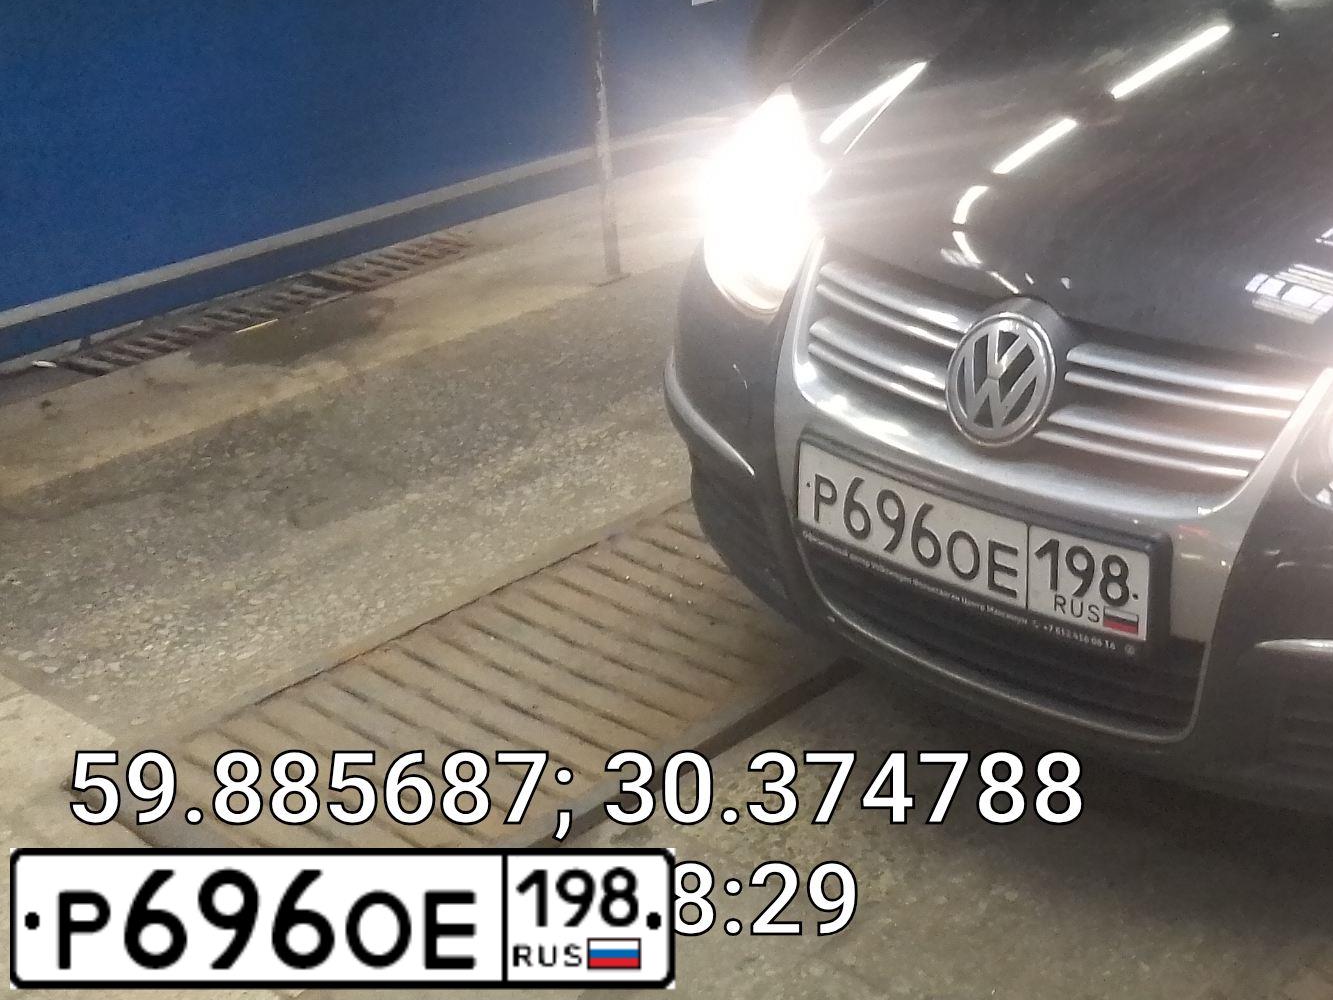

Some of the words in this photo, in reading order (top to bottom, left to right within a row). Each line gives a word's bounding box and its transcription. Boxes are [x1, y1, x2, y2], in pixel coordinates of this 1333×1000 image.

[812, 472, 1020, 600] Р696ОЕ
[1033, 537, 1131, 607] 198
[1053, 593, 1101, 624] RUS
